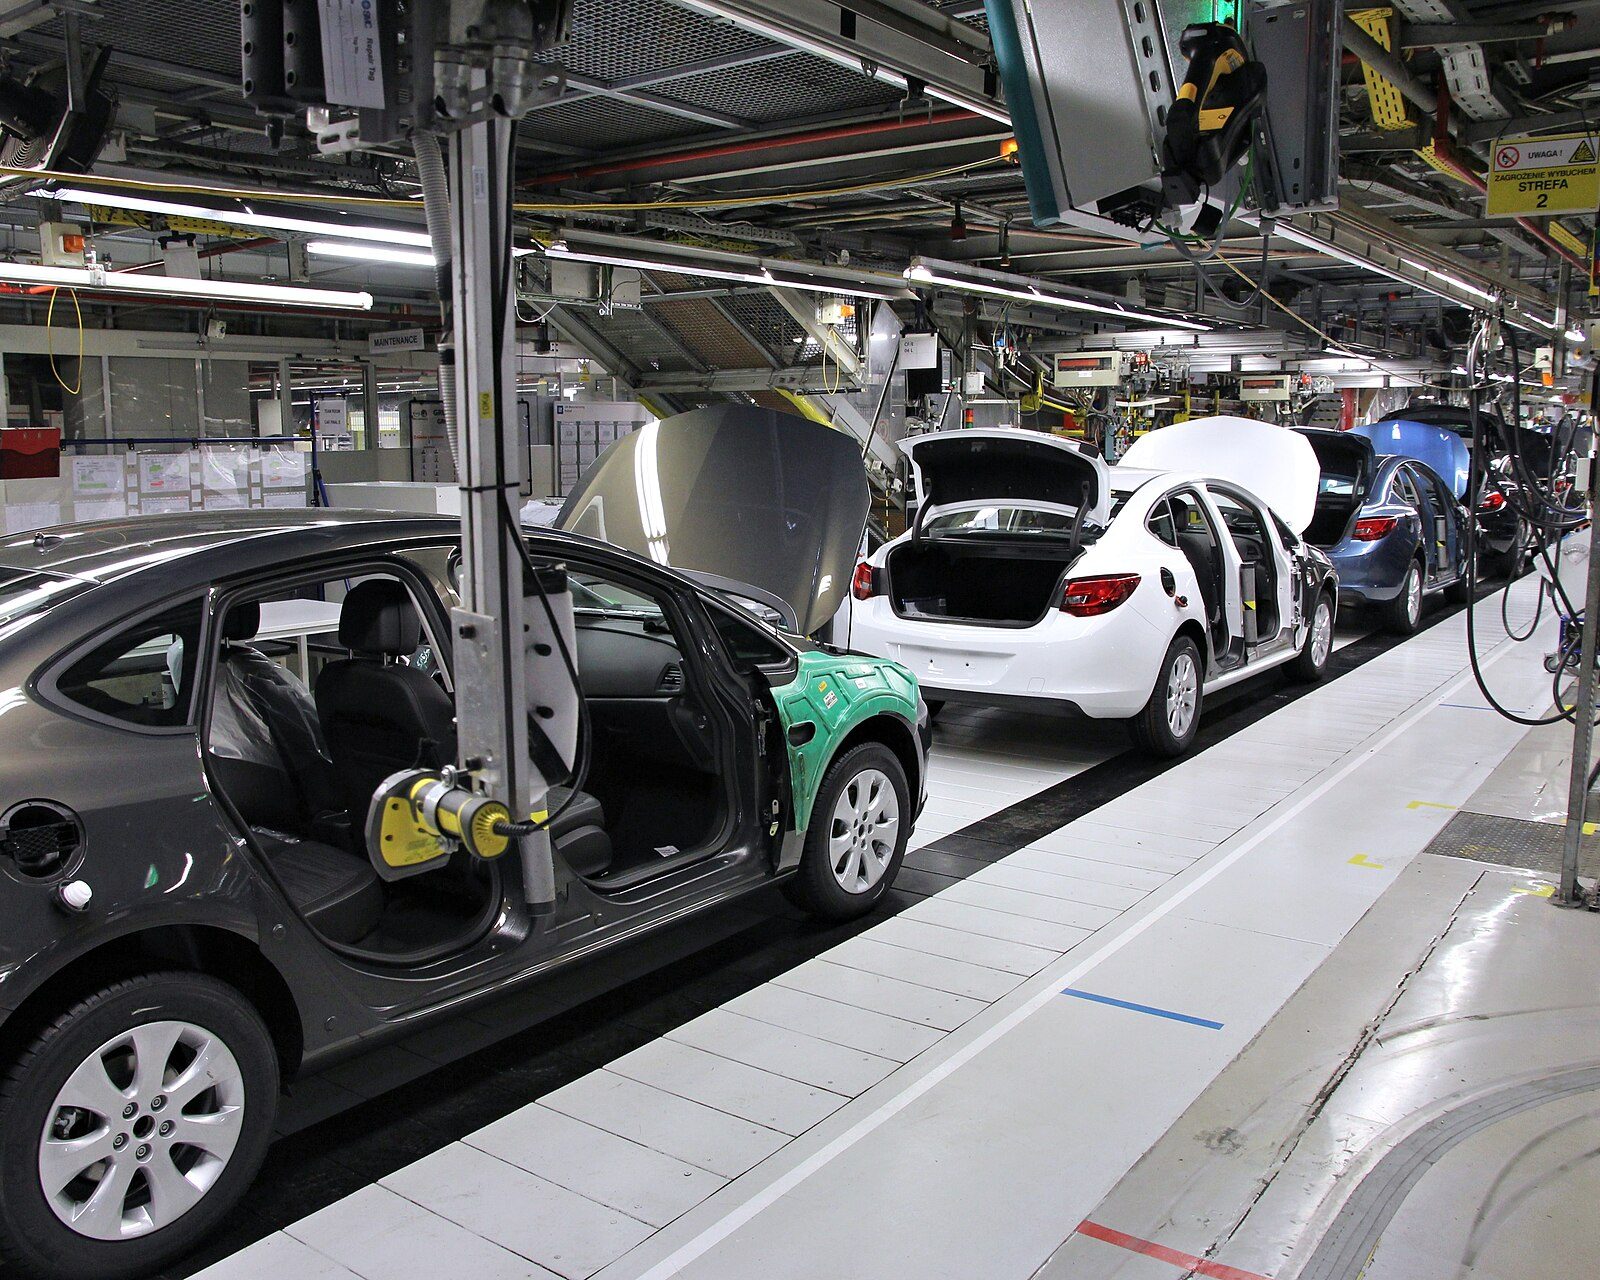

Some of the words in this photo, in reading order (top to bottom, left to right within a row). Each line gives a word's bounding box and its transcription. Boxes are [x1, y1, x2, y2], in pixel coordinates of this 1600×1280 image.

[366, 37, 375, 65] Repair
[1528, 150, 1558, 159] UWAGA
[1547, 167, 1596, 178] WYBUCHEM
[1518, 179, 1569, 192] STREFA
[1536, 193, 1548, 208] 2
[374, 335, 418, 347] MAINTENANCE
